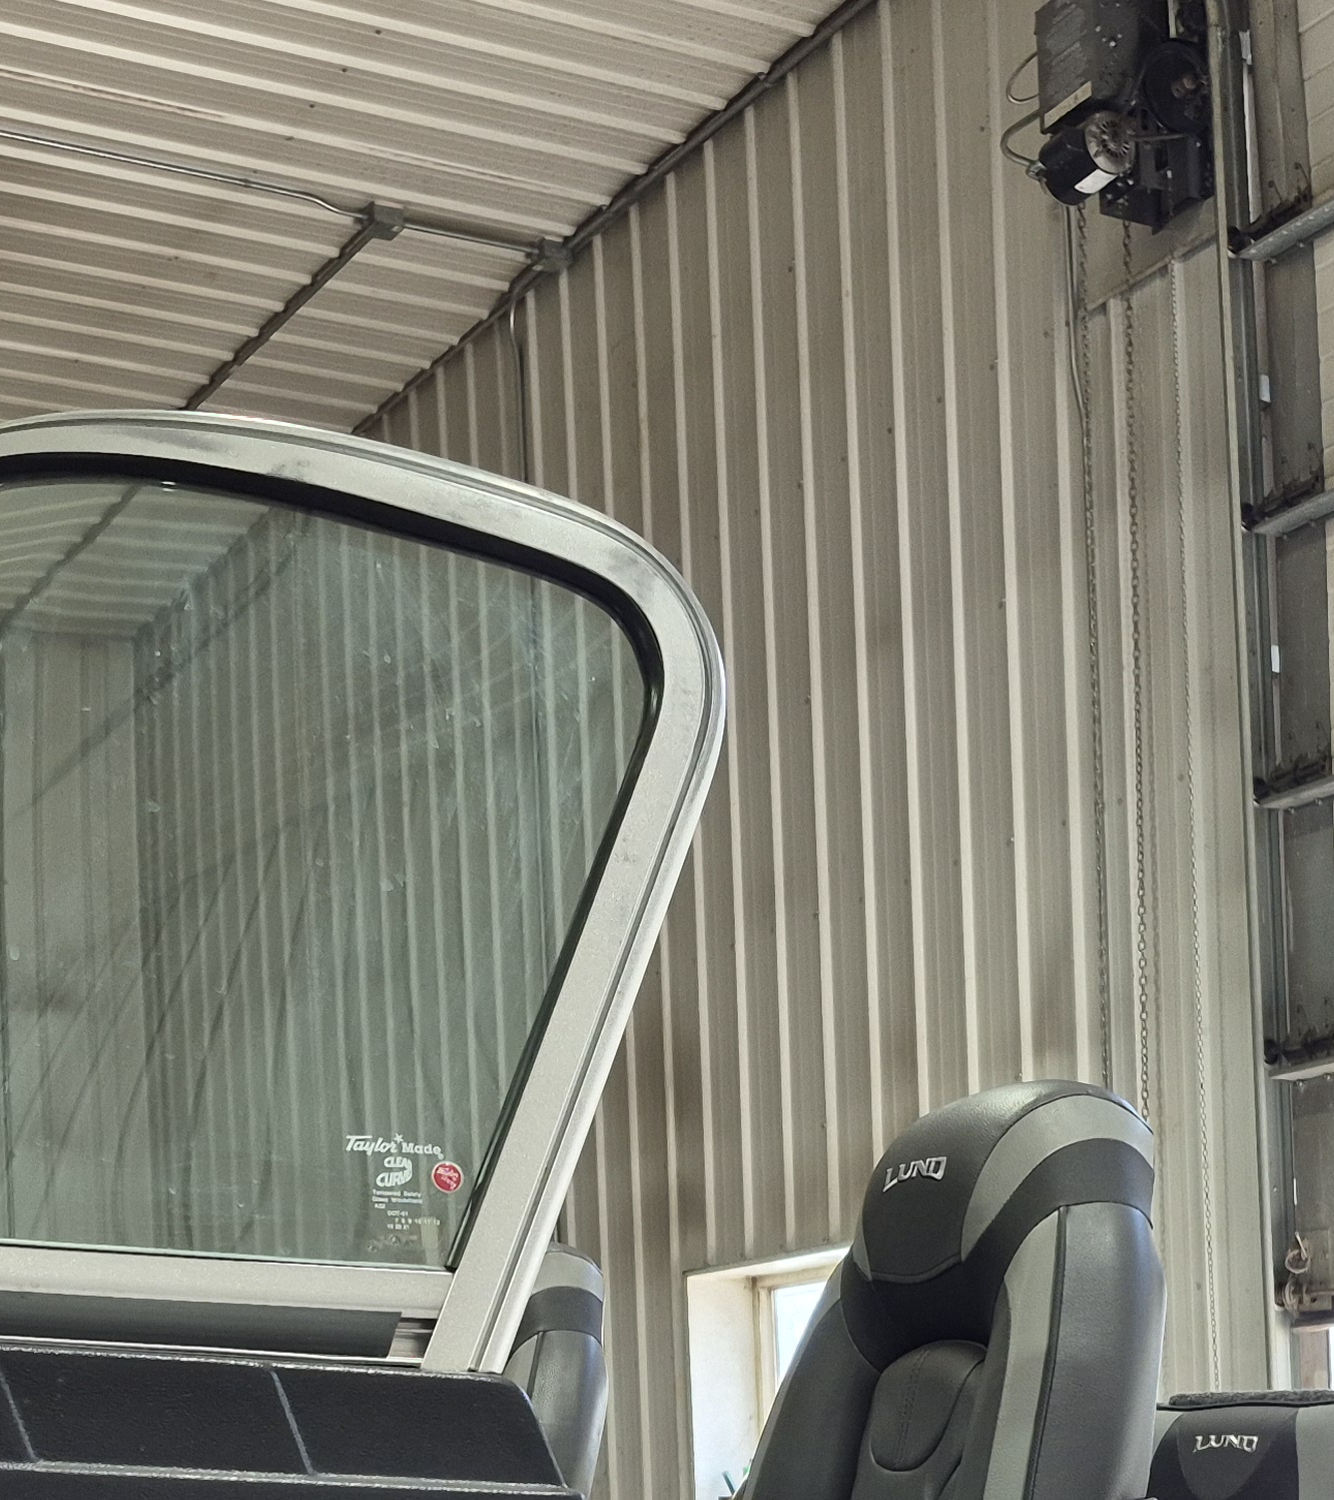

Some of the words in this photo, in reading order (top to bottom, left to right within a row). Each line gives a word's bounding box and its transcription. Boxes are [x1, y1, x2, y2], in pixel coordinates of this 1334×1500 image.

[346, 1135, 398, 1156] Taylor
[402, 1142, 441, 1154] Made
[882, 1156, 947, 1193] LUND
[1192, 1434, 1259, 1453] LUND
